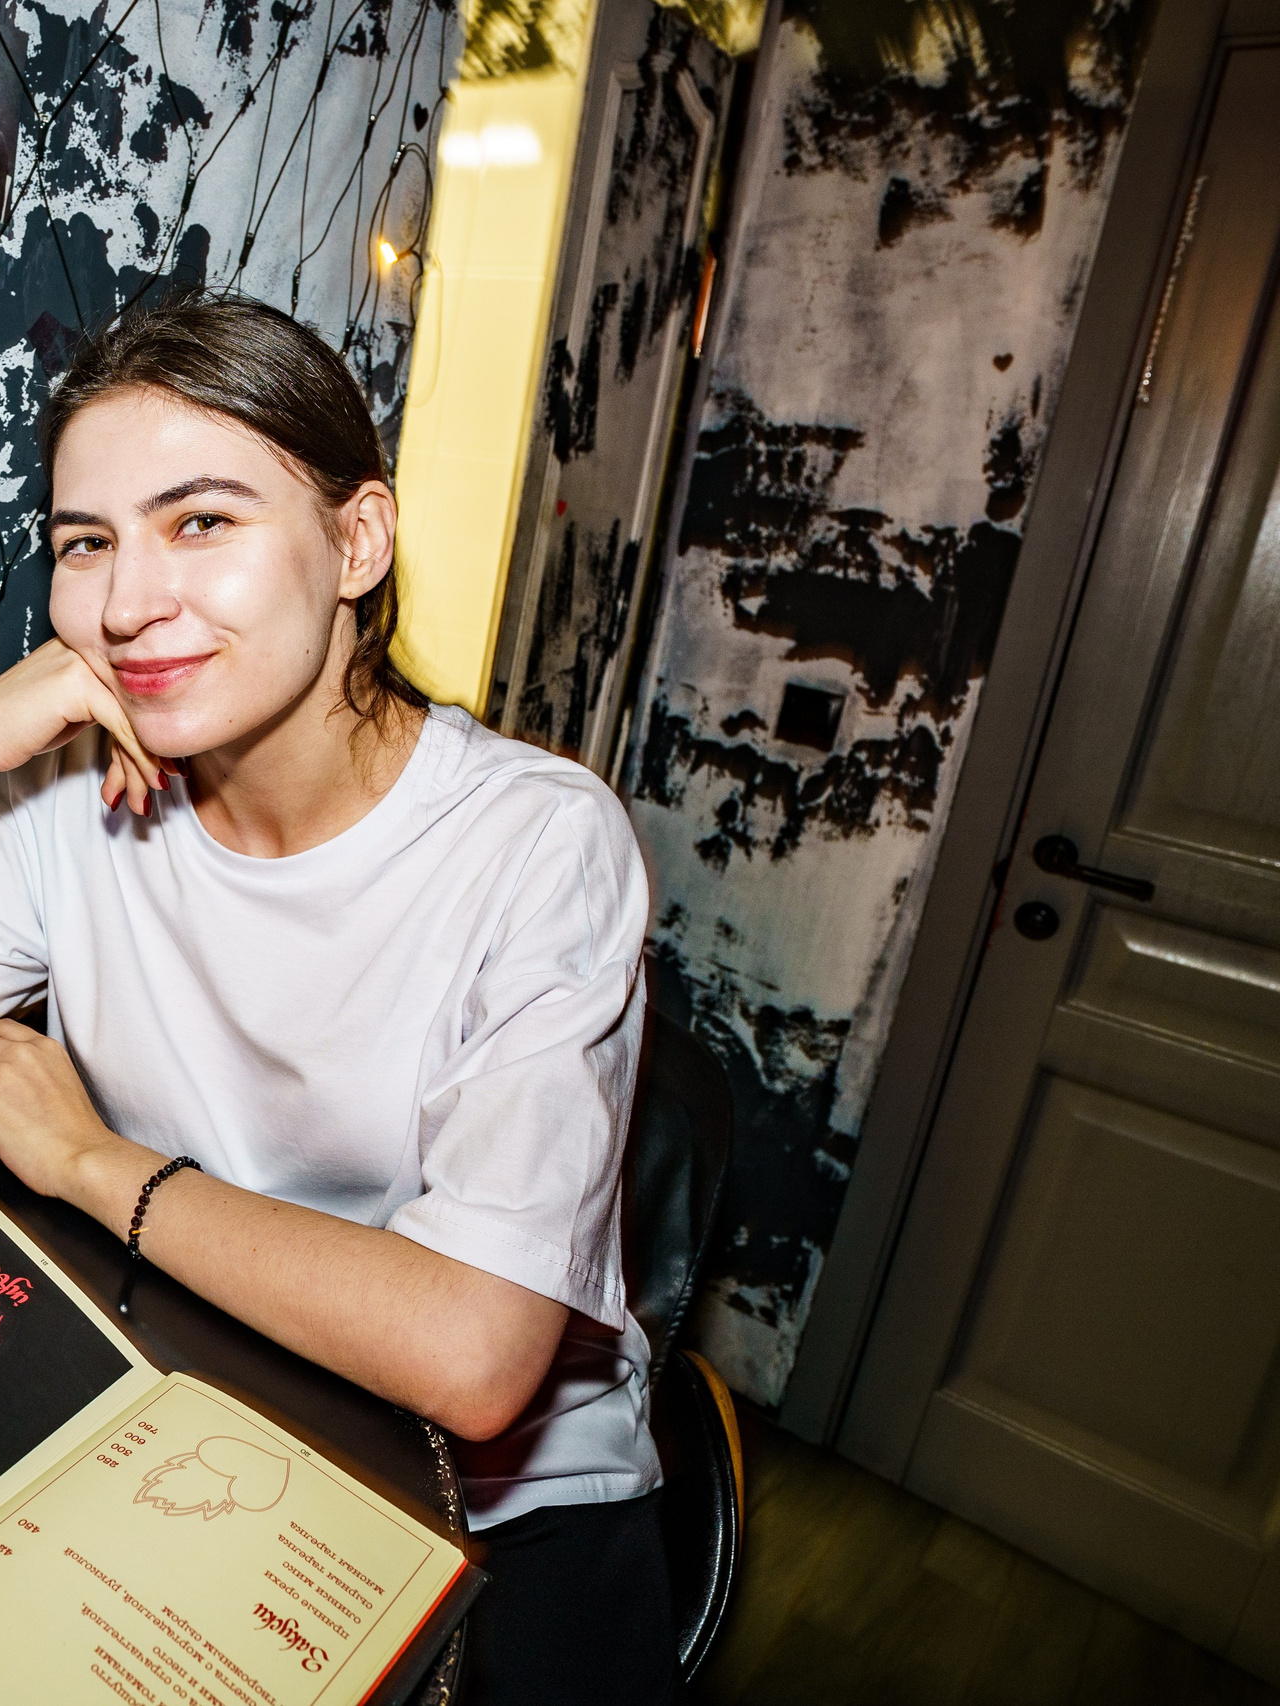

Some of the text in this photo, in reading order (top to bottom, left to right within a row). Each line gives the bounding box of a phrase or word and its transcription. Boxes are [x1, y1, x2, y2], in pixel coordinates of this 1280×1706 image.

[110, 1443, 133, 1457] 300
[124, 1431, 146, 1445] 600
[137, 1421, 158, 1435] 750
[300, 1448, 311, 1457] 20
[96, 1454, 119, 1468] 250
[17, 1518, 41, 1534] 450
[63, 1547, 123, 1592] рукколой
[277, 1534, 373, 1610] сырная тарелка
[289, 1521, 386, 1596] мясная тарелка
[263, 1569, 350, 1641] пряные орехи
[282, 1561, 362, 1625] оливки микс
[81, 1602, 188, 1699] со страчаттеллой,
[123, 1589, 204, 1664] мортаделлой,
[160, 1605, 277, 1706] творожным сыром
[252, 1602, 330, 1673] Закуски
[94, 1645, 156, 1704] томатами
[152, 1645, 188, 1679] песто
